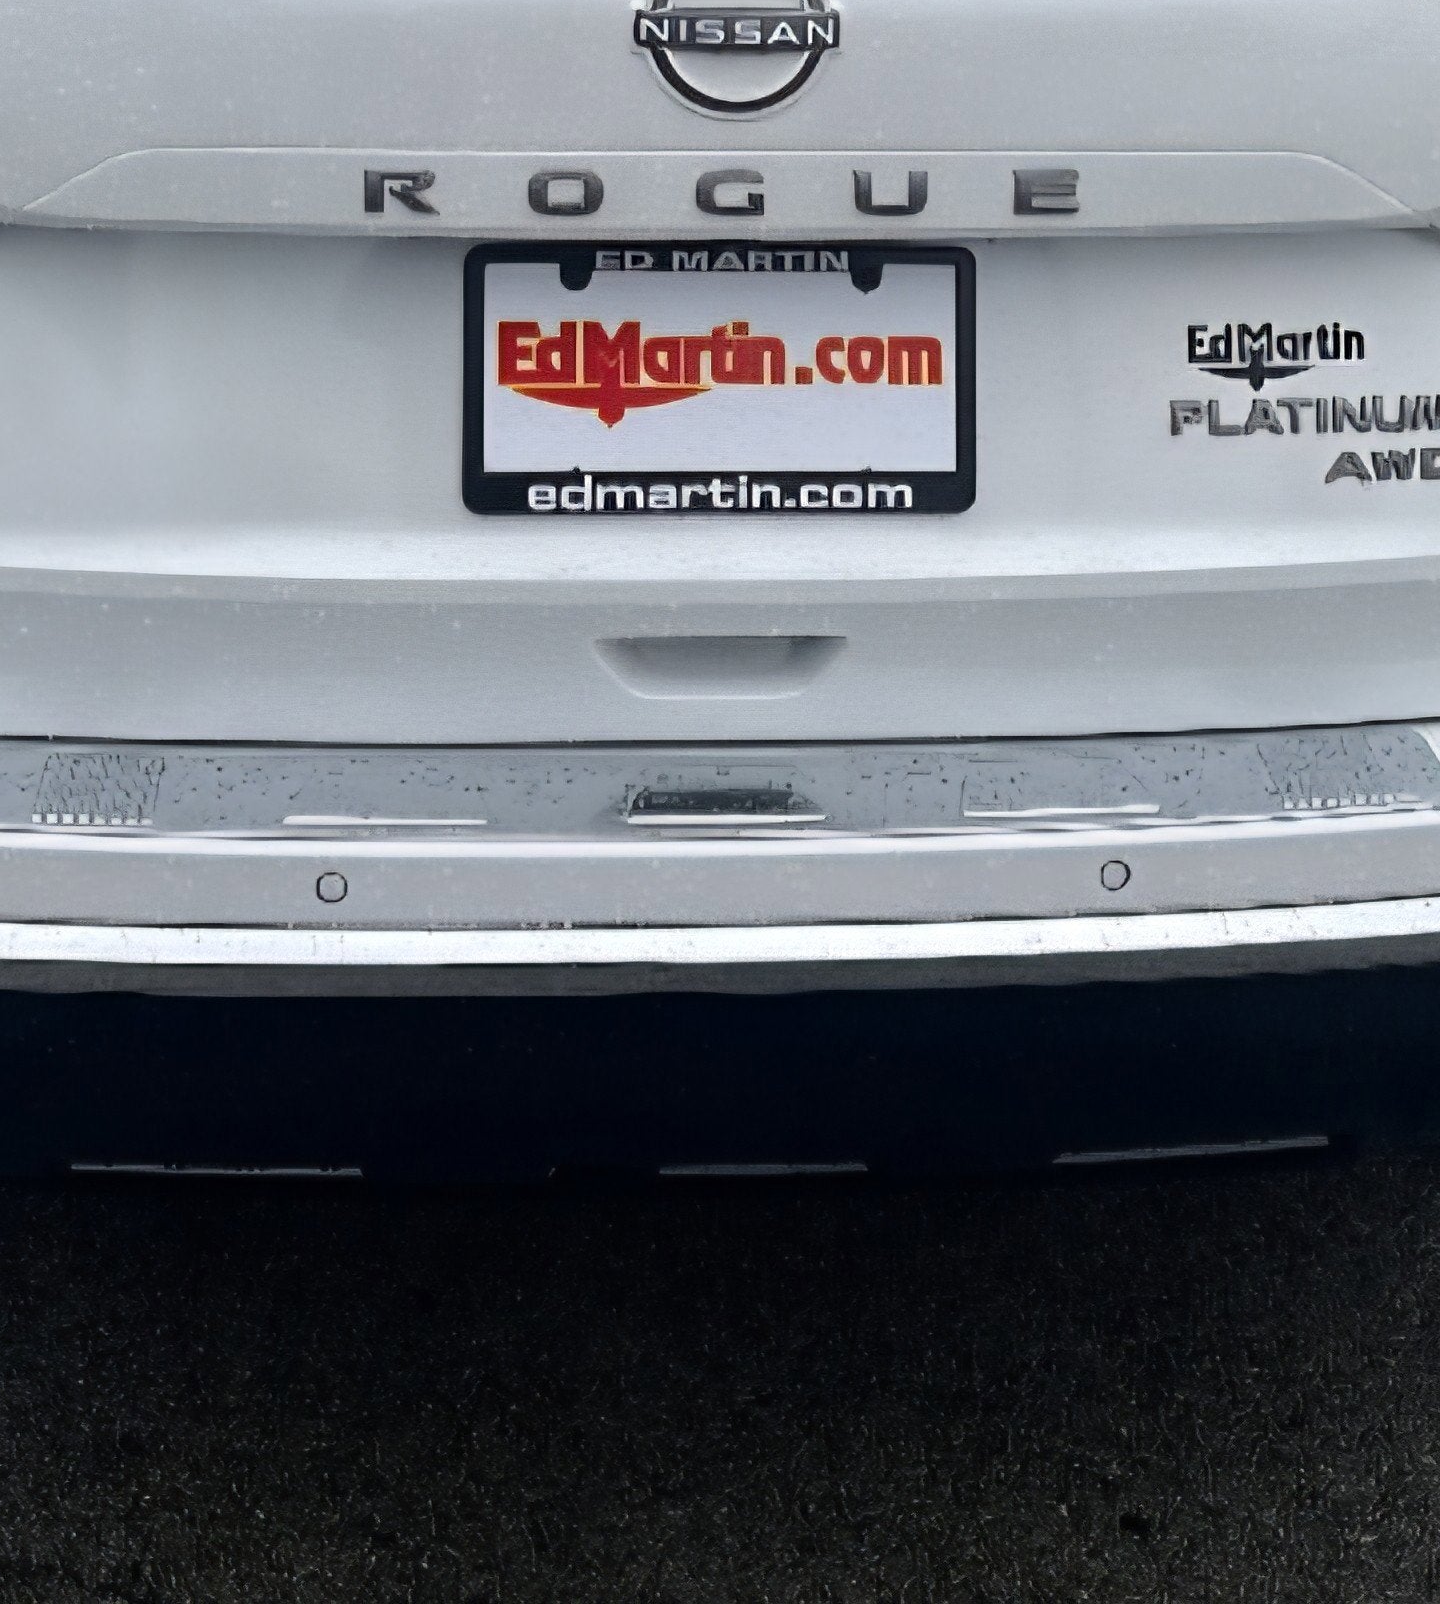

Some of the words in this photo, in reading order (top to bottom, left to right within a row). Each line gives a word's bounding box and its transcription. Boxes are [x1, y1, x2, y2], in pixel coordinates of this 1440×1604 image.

[639, 17, 836, 46] NISSAN
[363, 168, 1081, 216] ROGUE
[595, 250, 655, 270] ED
[672, 250, 849, 272] MARTIN
[497, 320, 943, 388] EdMartin.com
[527, 475, 914, 512] edmartin.com
